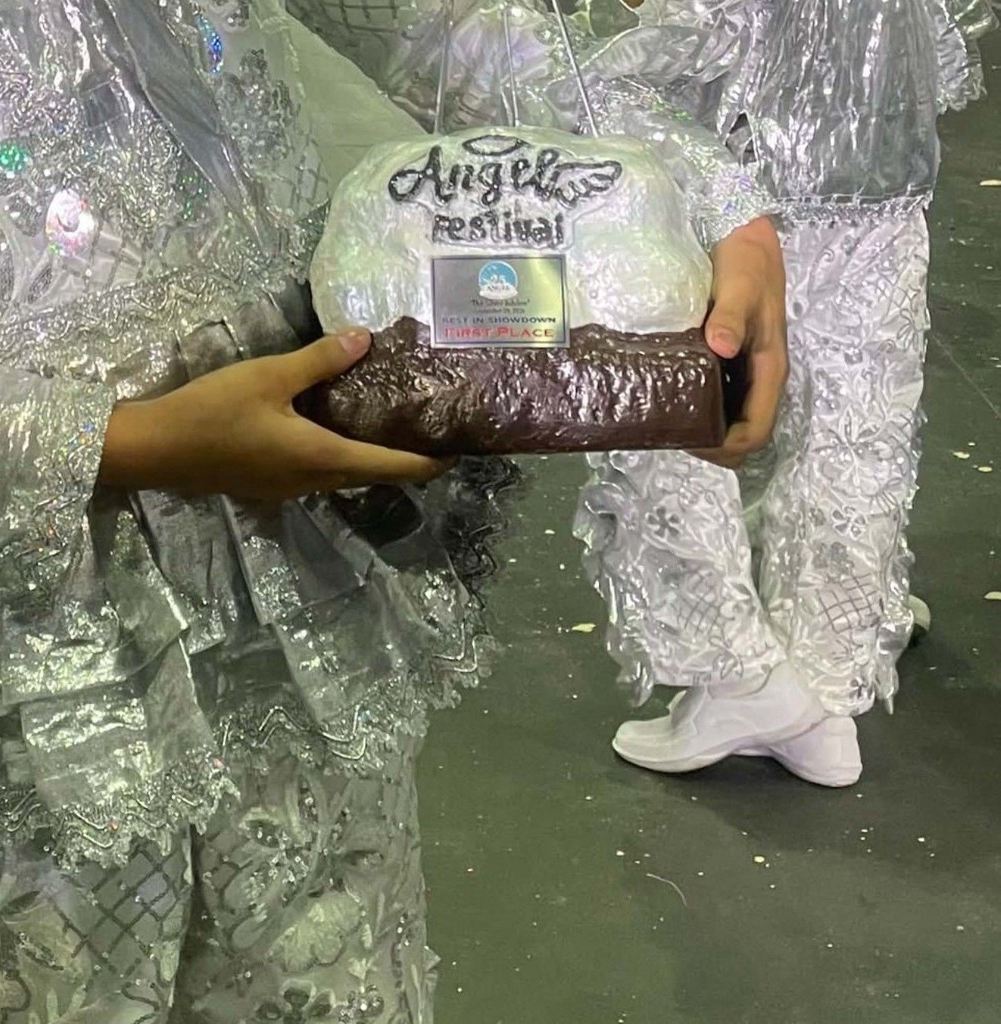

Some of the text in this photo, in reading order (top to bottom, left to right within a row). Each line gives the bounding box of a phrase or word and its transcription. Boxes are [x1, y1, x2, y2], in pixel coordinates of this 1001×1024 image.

[388, 144, 558, 207] Angel
[445, 326, 555, 338] FIRST PLACE
